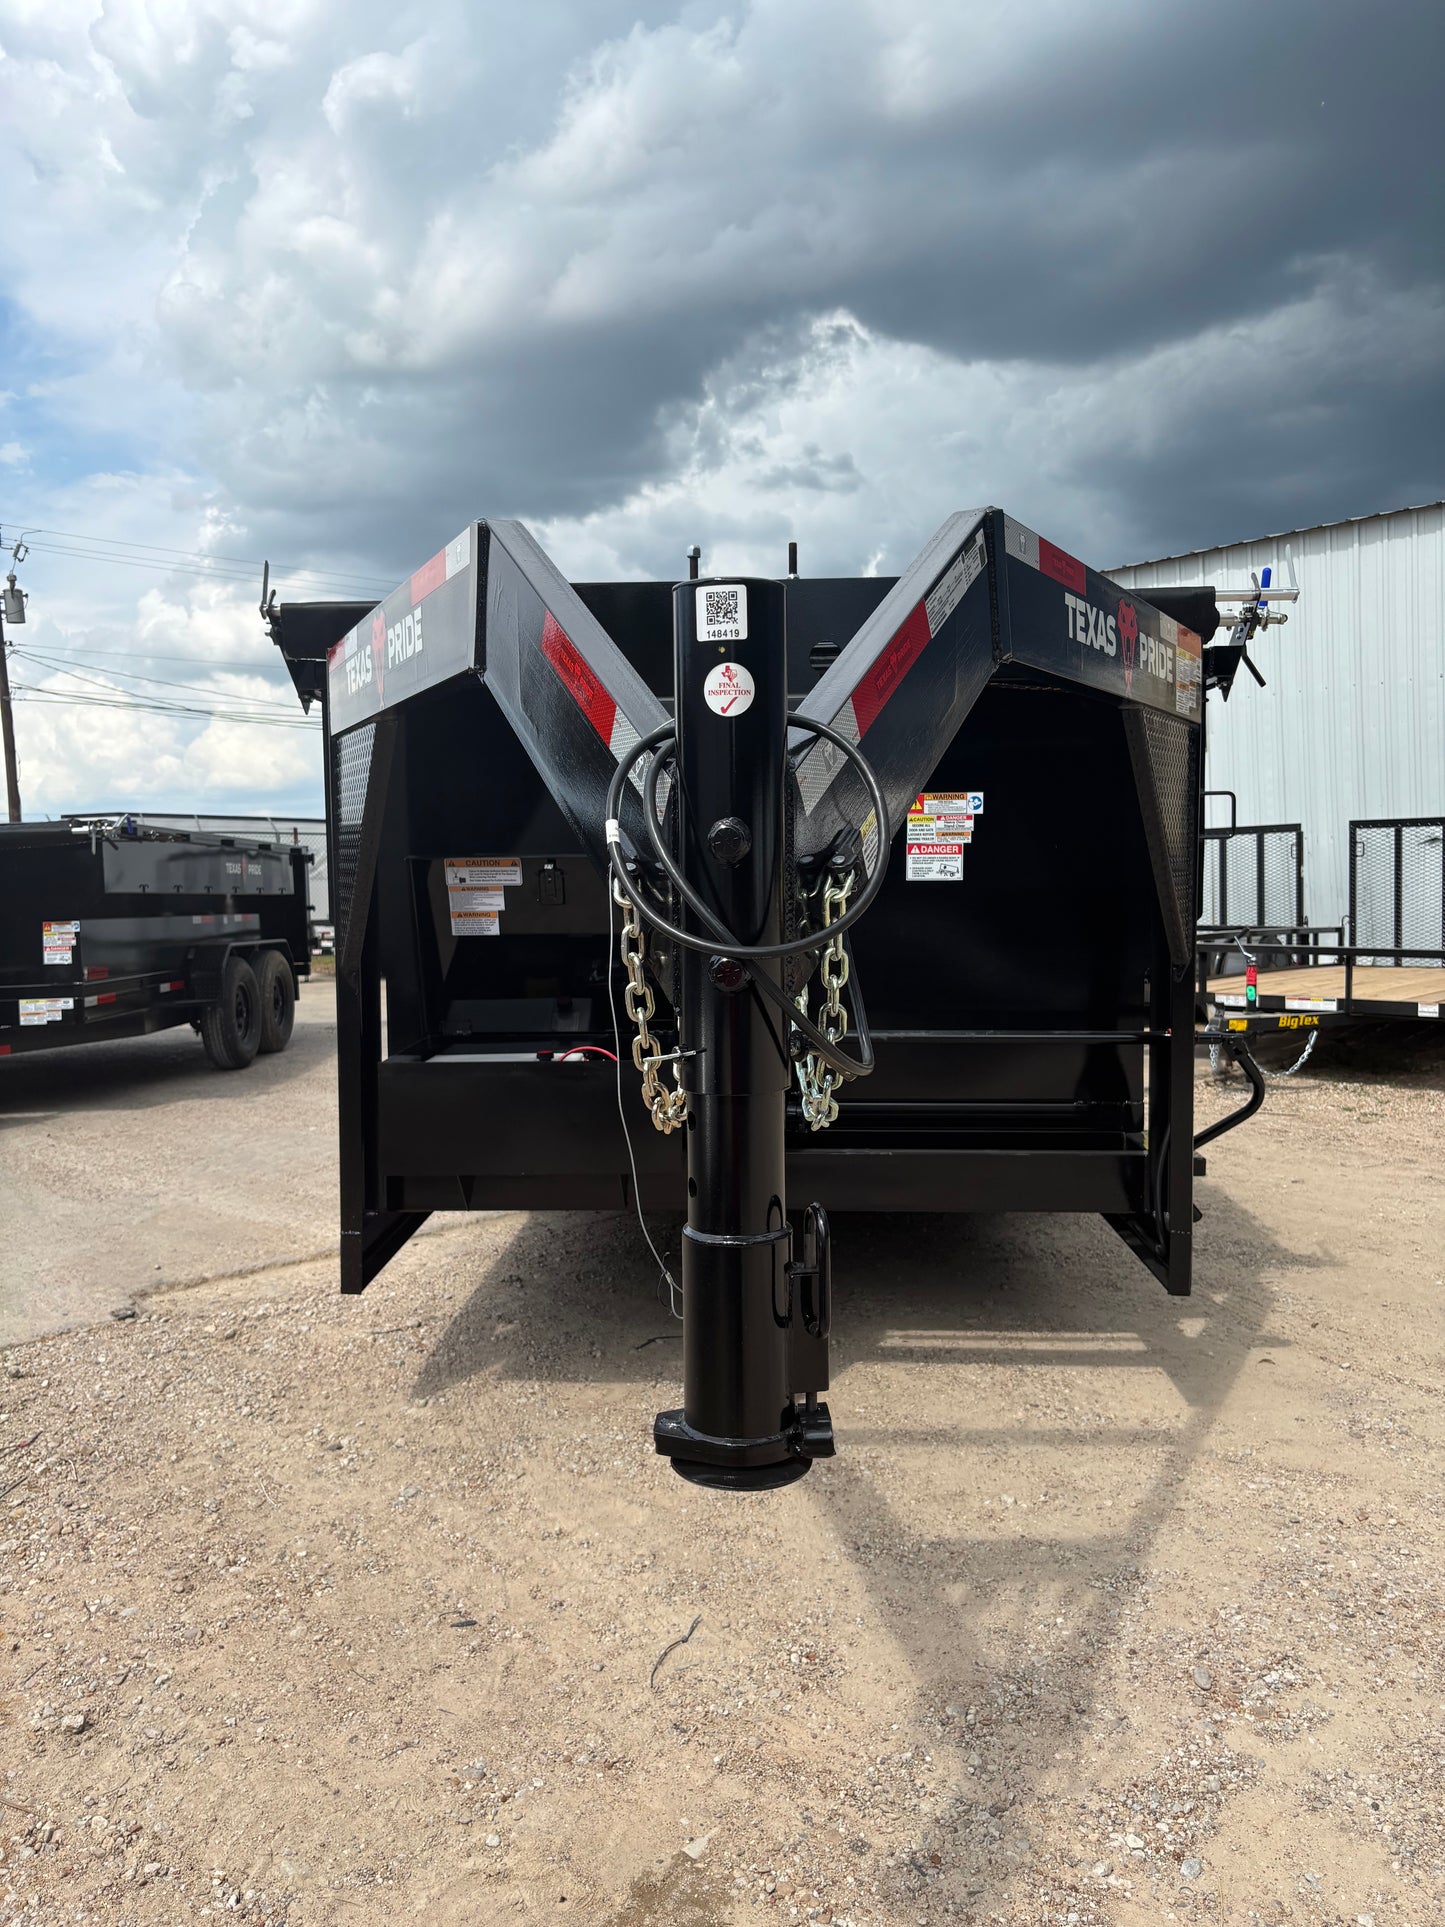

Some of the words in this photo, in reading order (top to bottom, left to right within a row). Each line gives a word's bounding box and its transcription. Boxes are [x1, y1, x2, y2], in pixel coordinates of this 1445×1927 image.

[706, 629, 740, 639] 148419
[1064, 592, 1117, 657] TEXAS
[1139, 632, 1174, 683] PRIDE
[345, 644, 372, 695] TEXAS
[387, 606, 423, 669] PRIDE
[920, 845, 959, 854] DANGER
[225, 862, 242, 874] TEXAS
[248, 863, 262, 875] PRIDE
[1278, 1015, 1320, 1029] BigTex
